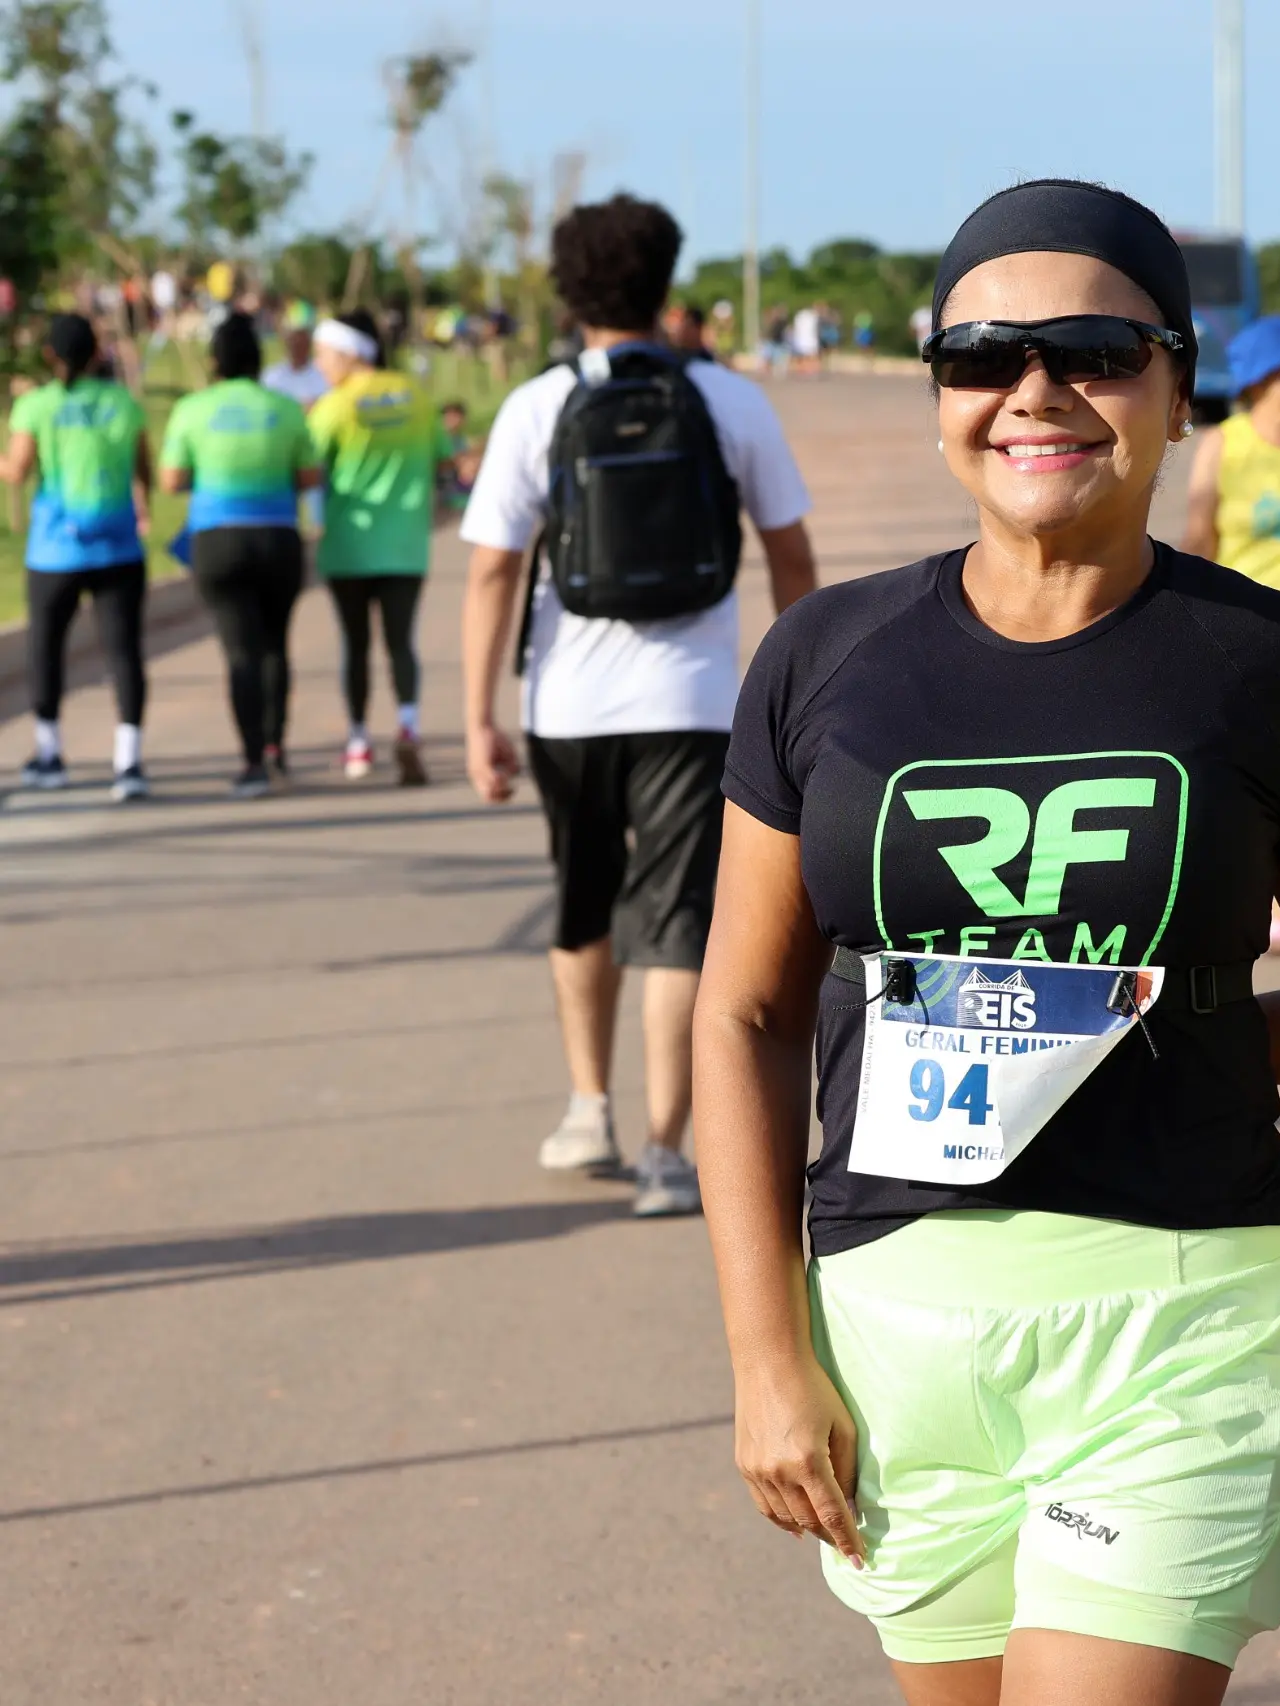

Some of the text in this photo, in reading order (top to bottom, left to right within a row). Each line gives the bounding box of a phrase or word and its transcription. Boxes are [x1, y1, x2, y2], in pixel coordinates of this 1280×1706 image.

[902, 778, 1156, 917] RF
[957, 991, 1037, 1030] REIS
[905, 1028, 971, 1054] GERAL
